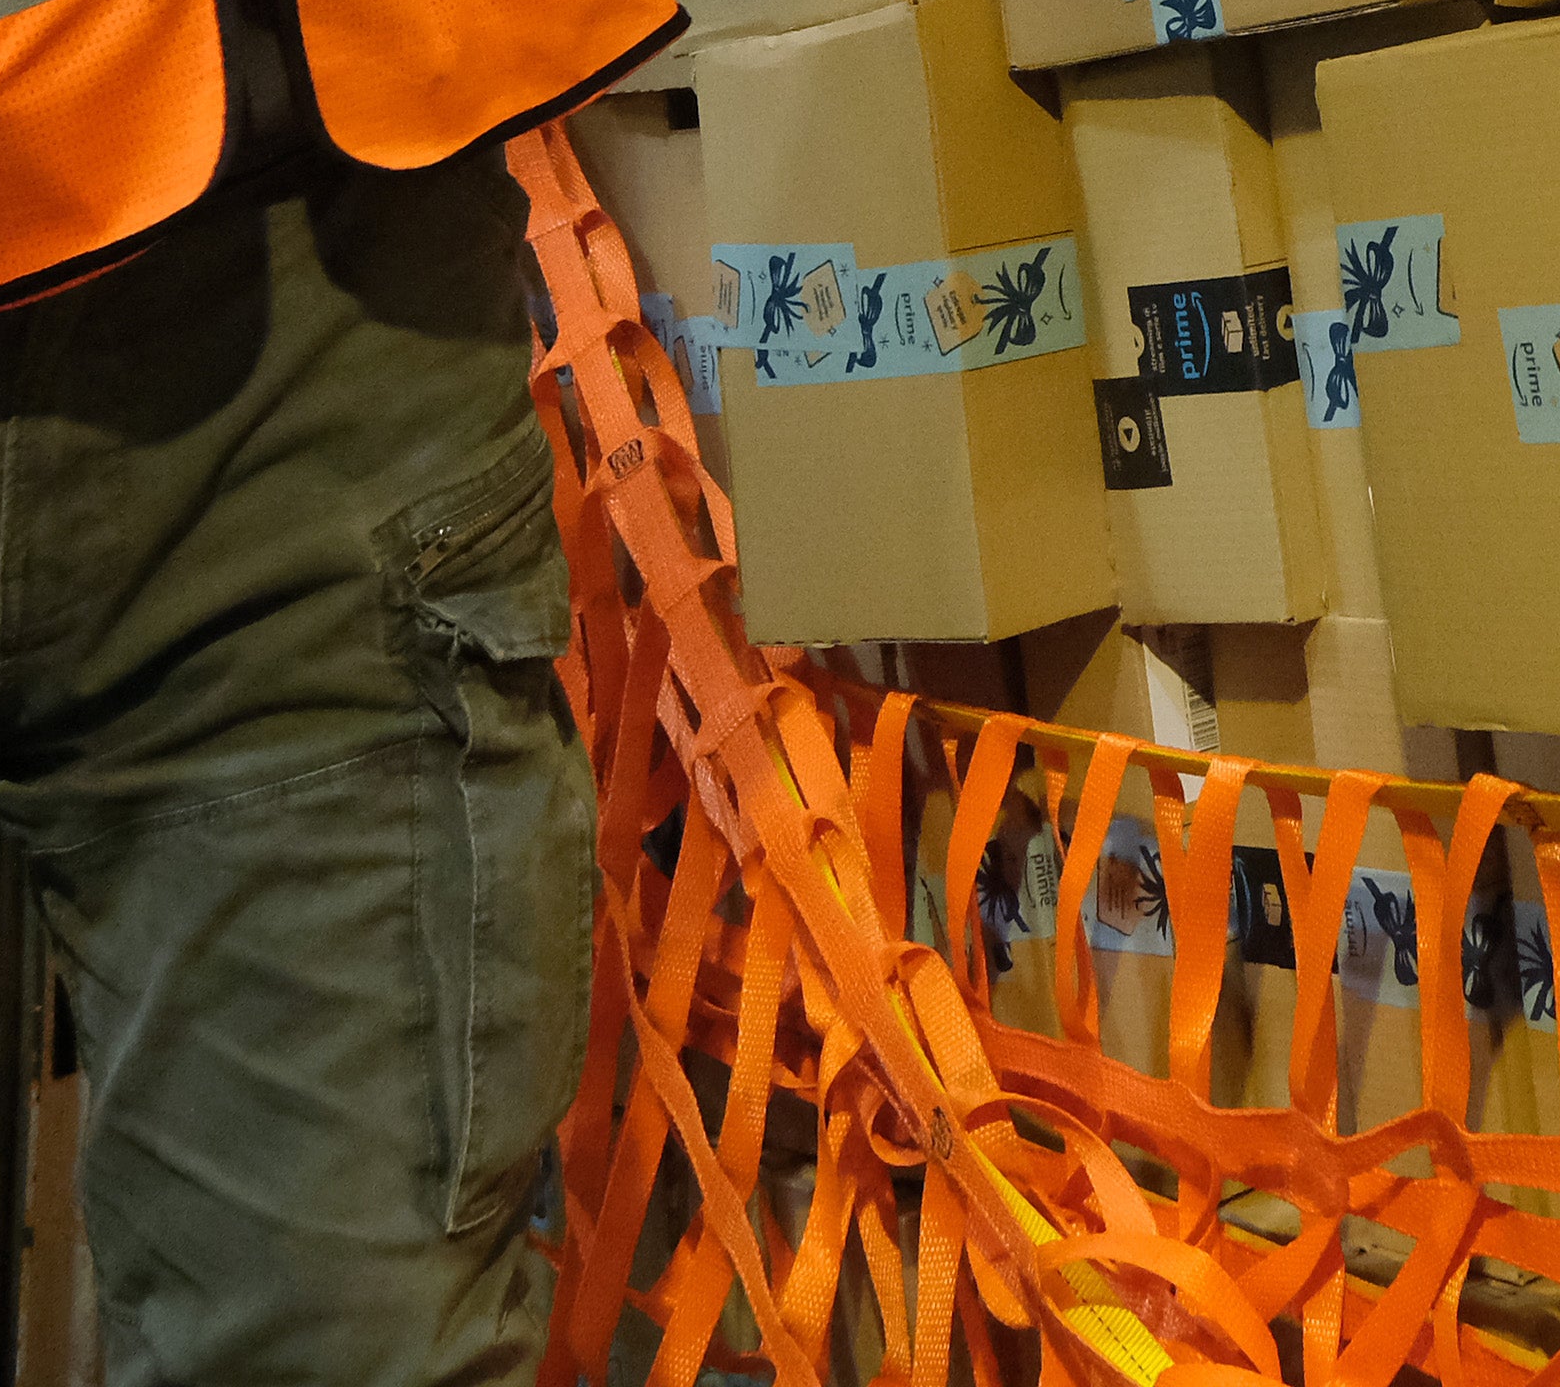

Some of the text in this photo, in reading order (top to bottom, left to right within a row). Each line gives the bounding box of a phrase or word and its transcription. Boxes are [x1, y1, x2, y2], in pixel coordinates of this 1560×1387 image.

[901, 293, 917, 346] prime
[1173, 292, 1201, 380] prime
[1519, 342, 1543, 408] prime
